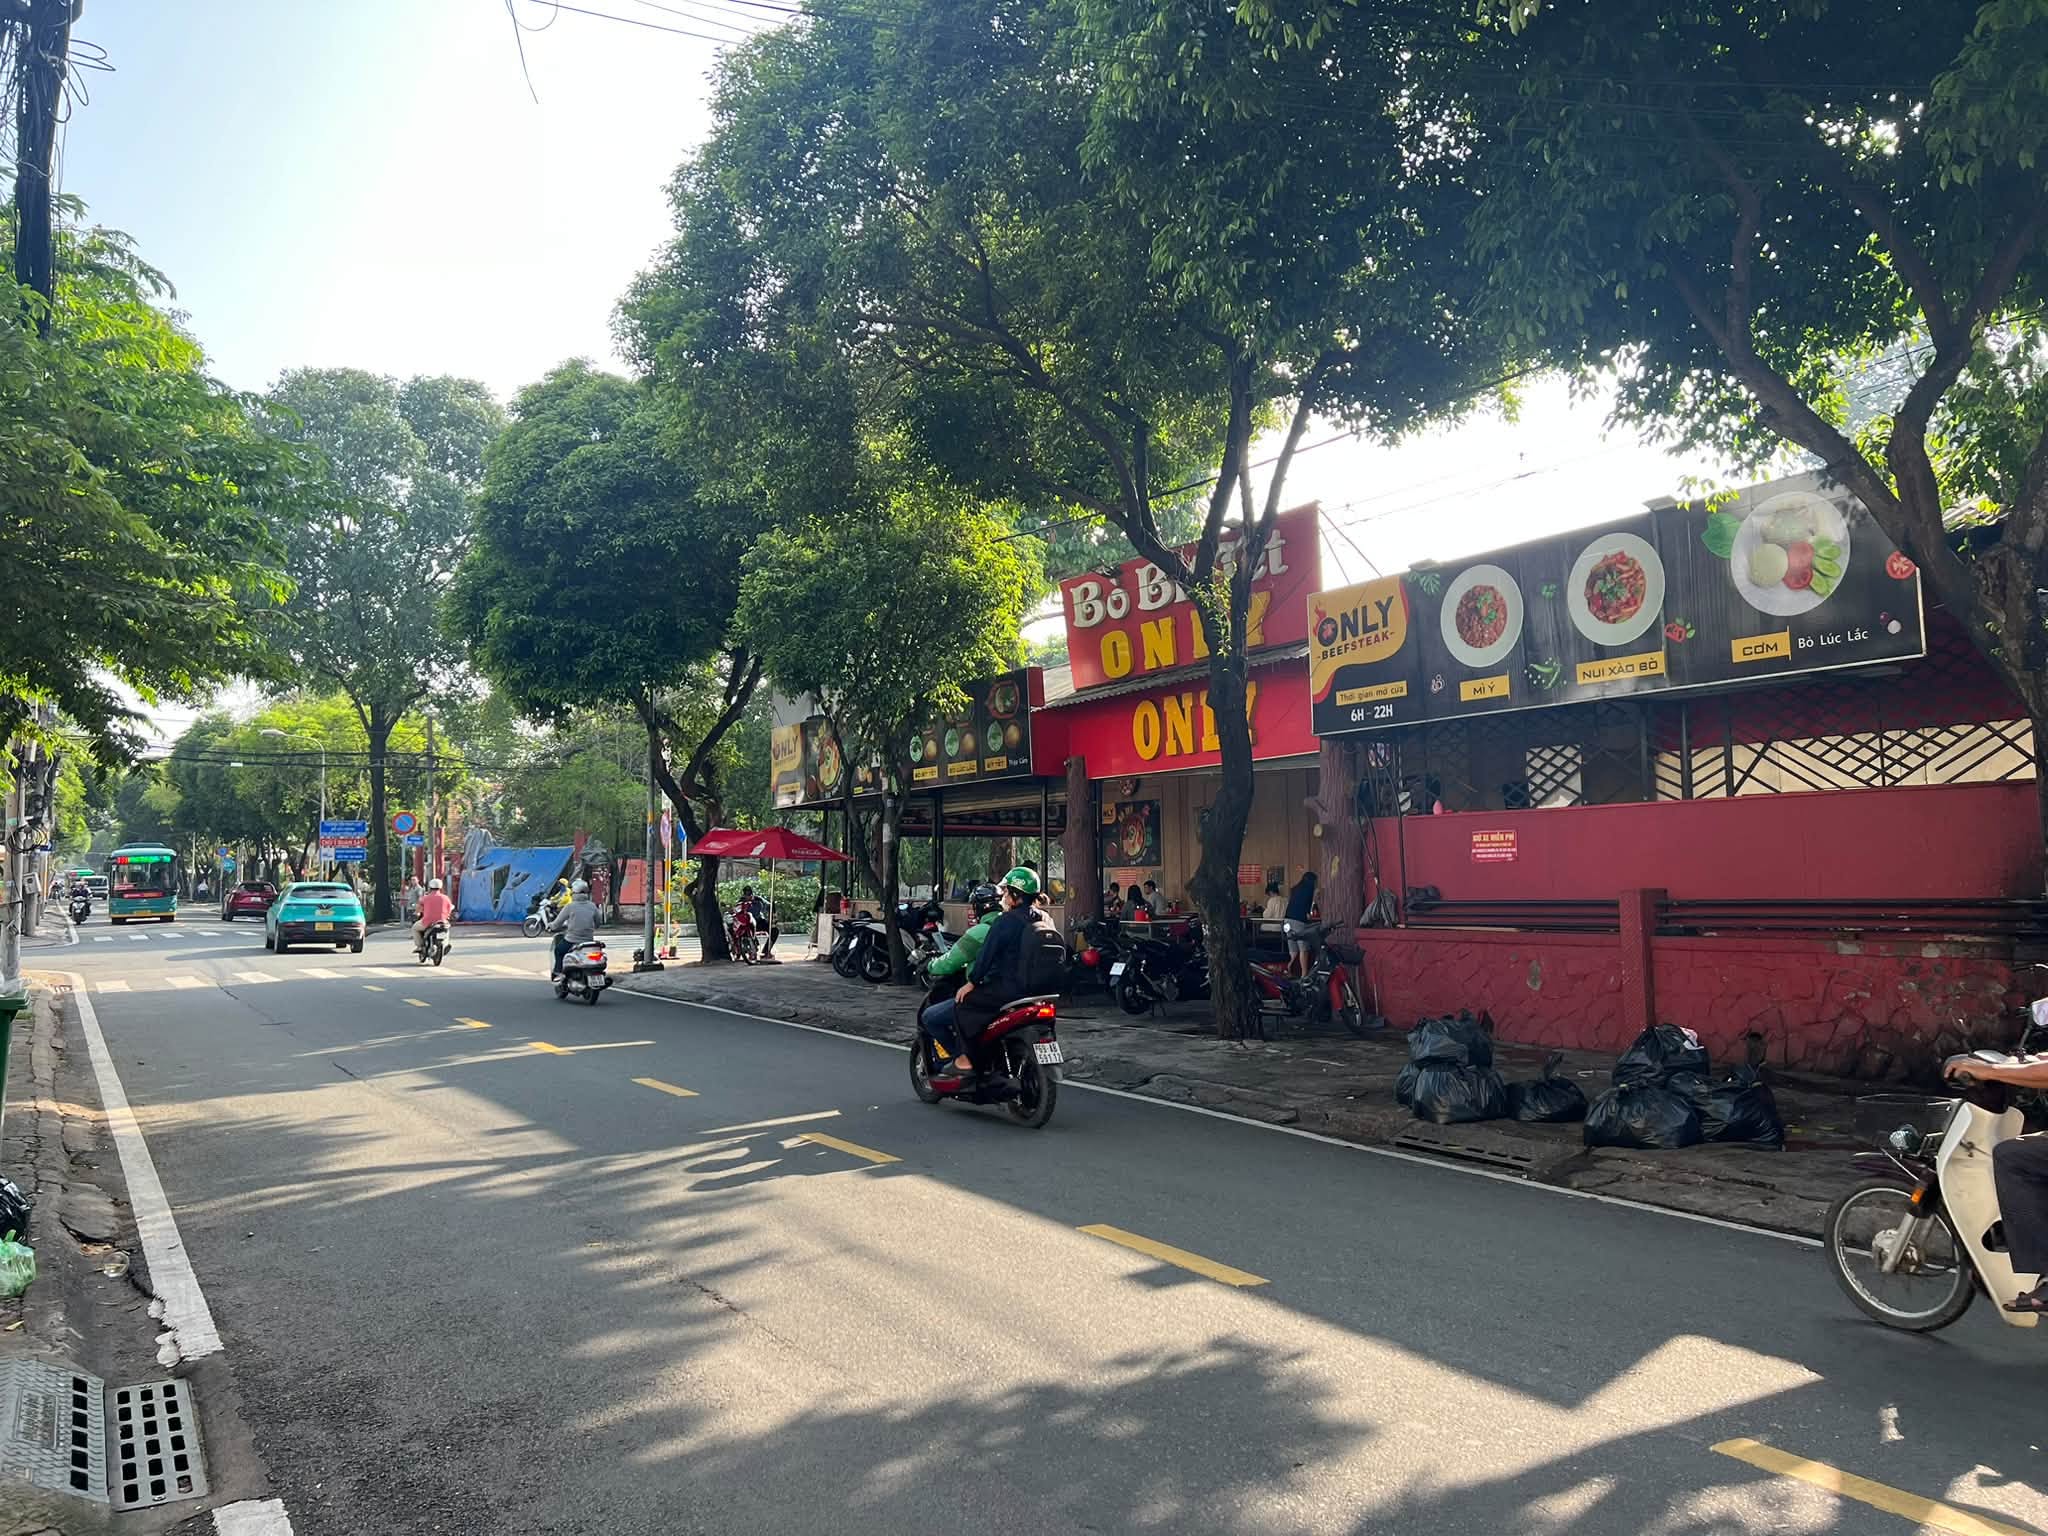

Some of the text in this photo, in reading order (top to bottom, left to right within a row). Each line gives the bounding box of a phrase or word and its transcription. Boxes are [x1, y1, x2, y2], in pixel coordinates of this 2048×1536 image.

[1071, 579, 1131, 628] Bò
[1318, 596, 1394, 647] ONLY
[1799, 628, 1869, 648] Bò Lúc Lắc
[1743, 642, 1778, 656] CƠM
[1583, 657, 1658, 680] NUI XÀO BÒ
[1472, 681, 1496, 695] MÌ Ý
[1351, 708, 1364, 722] 6H
[1374, 704, 1393, 719] 22H
